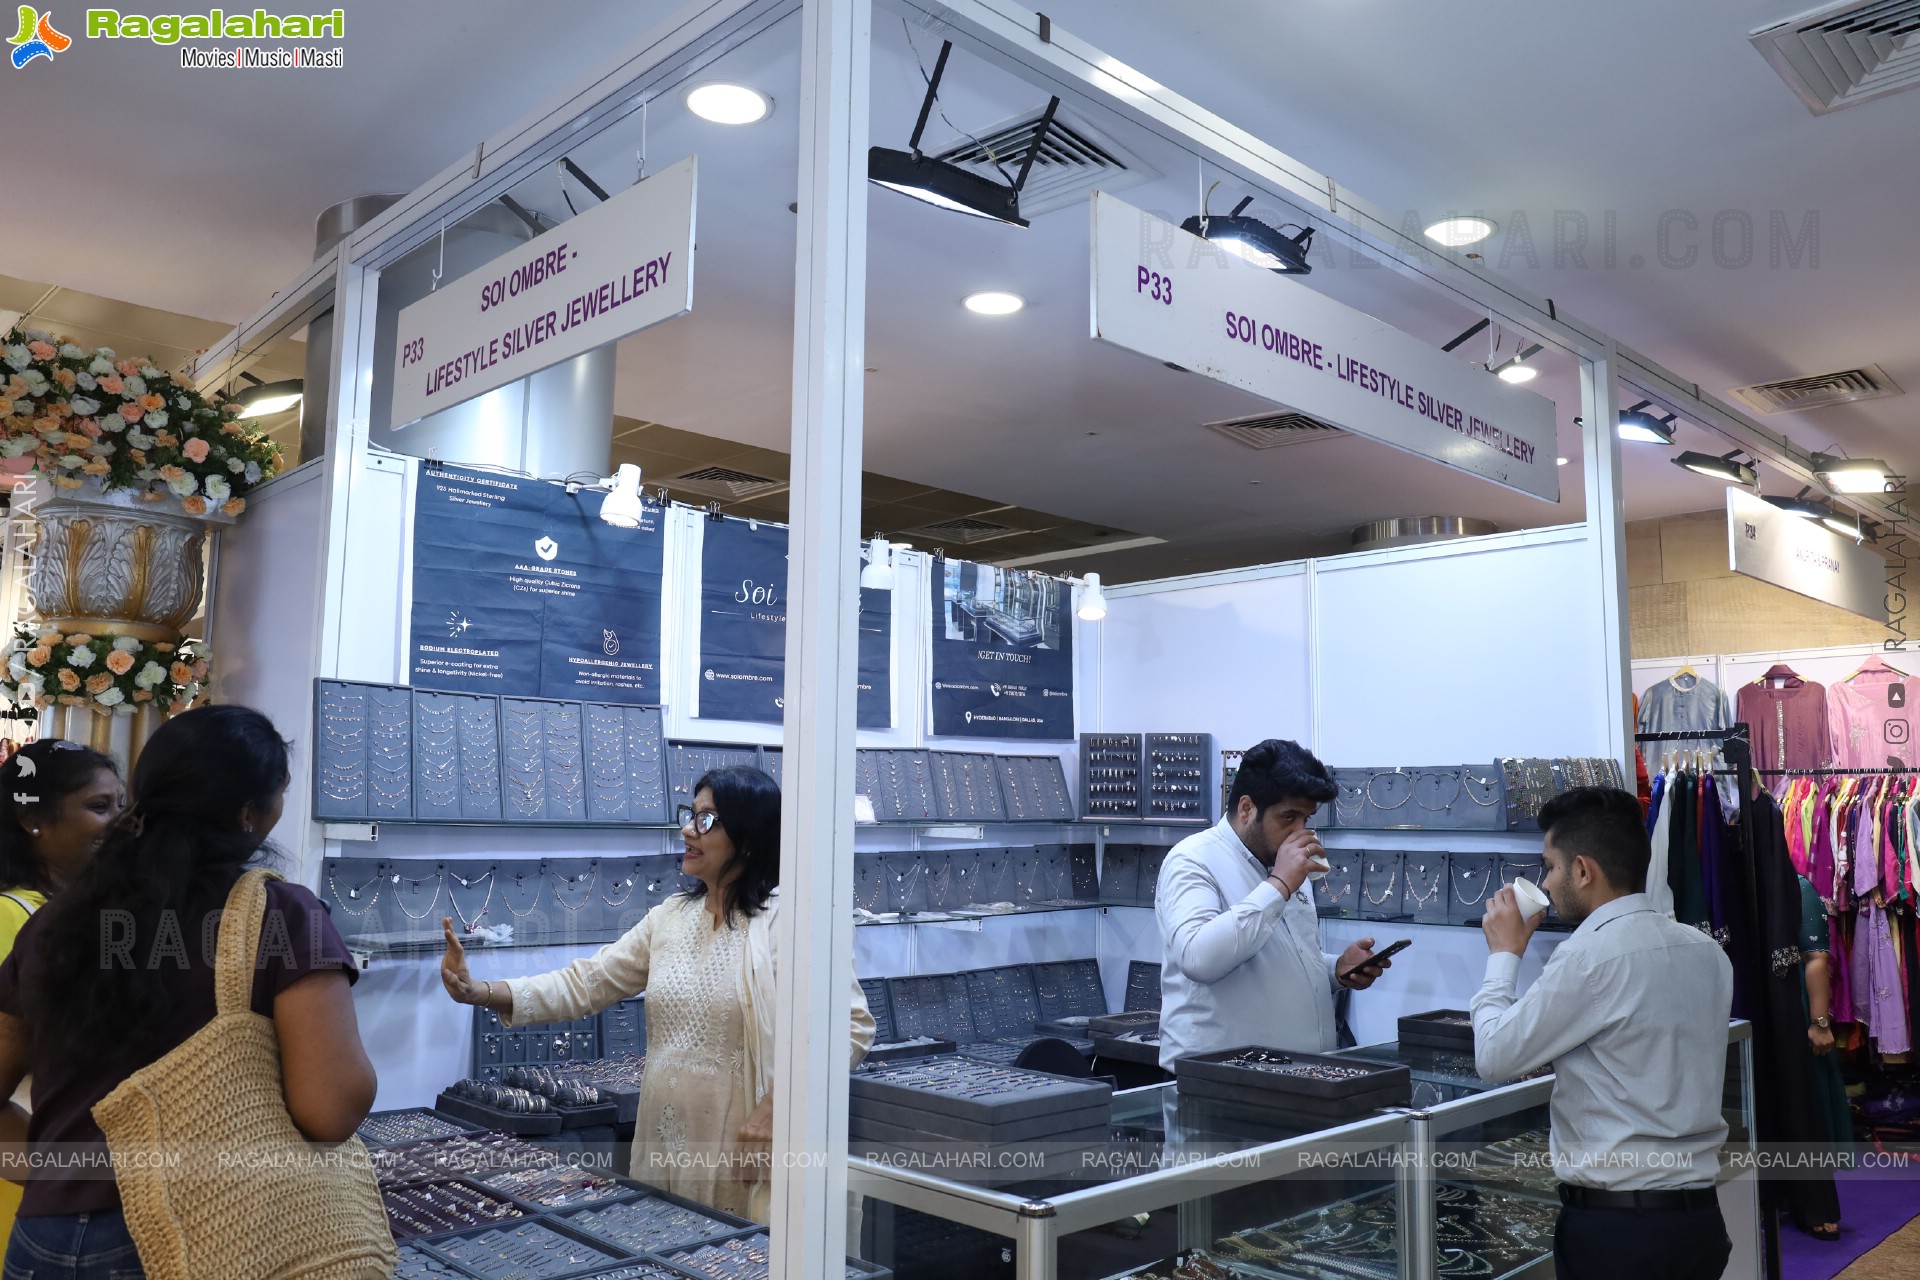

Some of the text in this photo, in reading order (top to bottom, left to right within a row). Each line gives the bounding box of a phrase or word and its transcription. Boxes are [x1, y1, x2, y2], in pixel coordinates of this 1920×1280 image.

[481, 276, 506, 312] SOI
[509, 243, 568, 297] OMBRE
[1137, 265, 1173, 305] P33
[426, 251, 672, 396] LIFESTYLE SILVER JEWELLERY
[402, 337, 424, 368] P33
[1225, 311, 1256, 345] SOI
[1262, 324, 1323, 370] OMBRE
[1337, 353, 1414, 410] LIFESTYLE
[1418, 391, 1463, 432] SILVER
[1466, 416, 1535, 465] JEWELLERY
[426, 469, 518, 490] AUTHENTICITY CERTIFICATE
[449, 495, 465, 503] Silver
[734, 578, 778, 606] Soi
[750, 612, 786, 623] Lifestyle
[420, 658, 444, 666] Superior
[620, 661, 653, 670] JEWELLERY
[995, 651, 1005, 661] IN
[715, 672, 773, 682] www.soiombre.com
